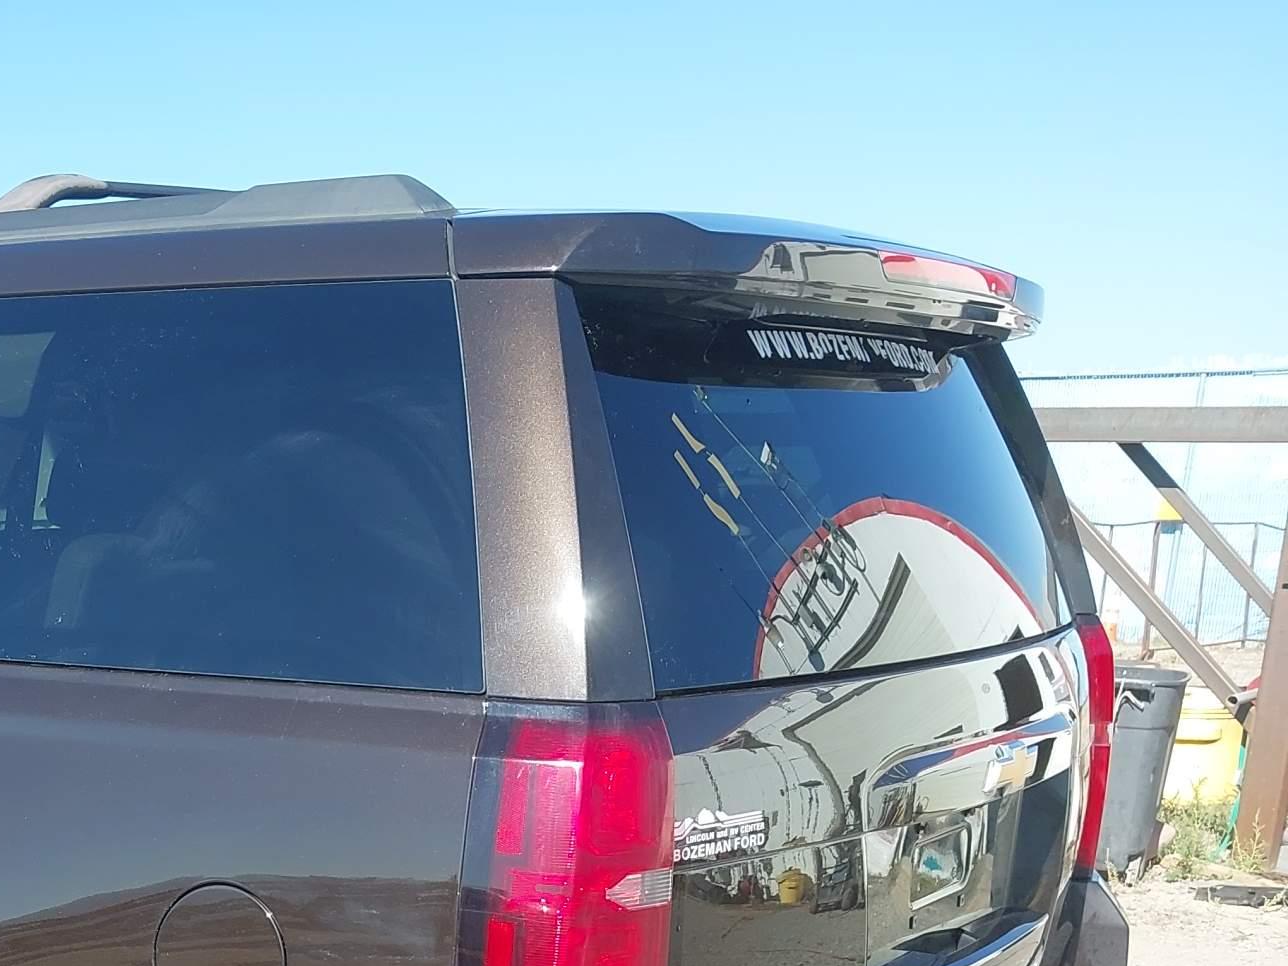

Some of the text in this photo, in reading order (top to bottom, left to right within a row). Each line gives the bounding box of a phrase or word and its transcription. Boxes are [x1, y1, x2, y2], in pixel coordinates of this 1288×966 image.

[685, 831, 715, 844] LINCOLN
[739, 821, 765, 834] CENTER
[673, 832, 765, 862] BOZEMAN FORD
